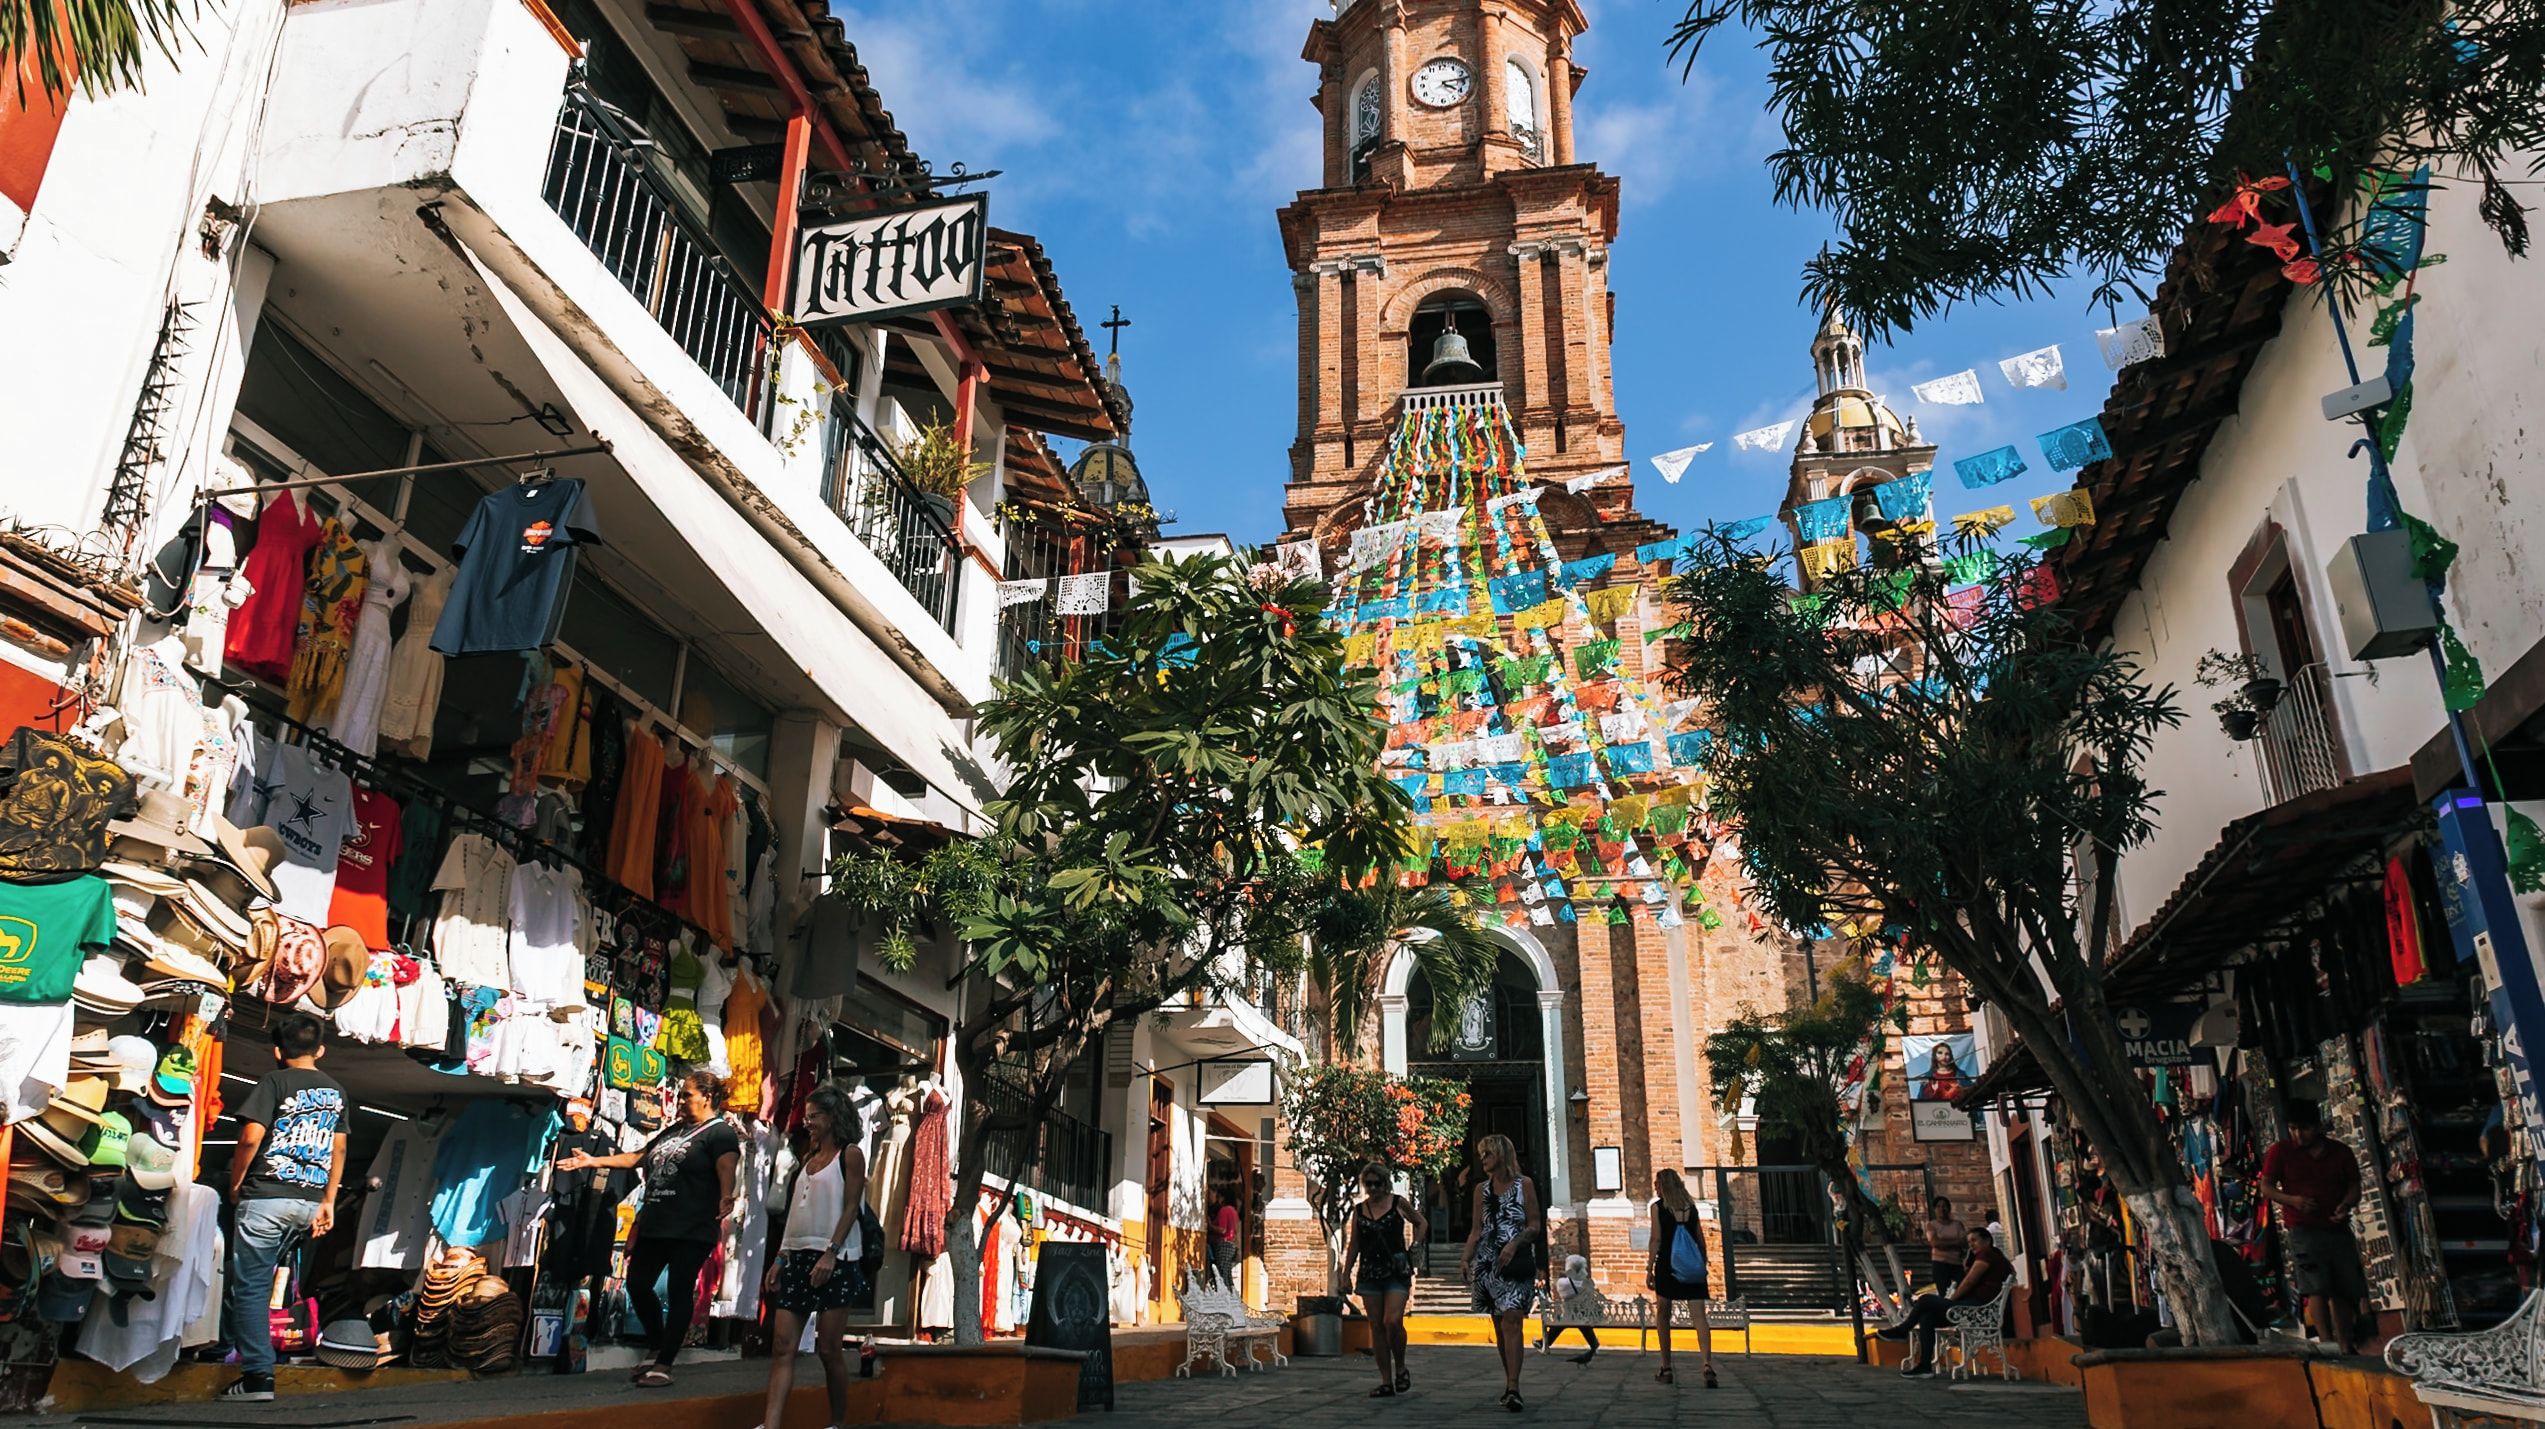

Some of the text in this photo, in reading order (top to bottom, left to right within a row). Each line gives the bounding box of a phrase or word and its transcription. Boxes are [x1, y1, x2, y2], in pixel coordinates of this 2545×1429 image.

[802, 207, 979, 321] Tattoo
[2124, 1039, 2191, 1058] MACIA
[1917, 1119, 1968, 1127] EL CAMPANARIO
